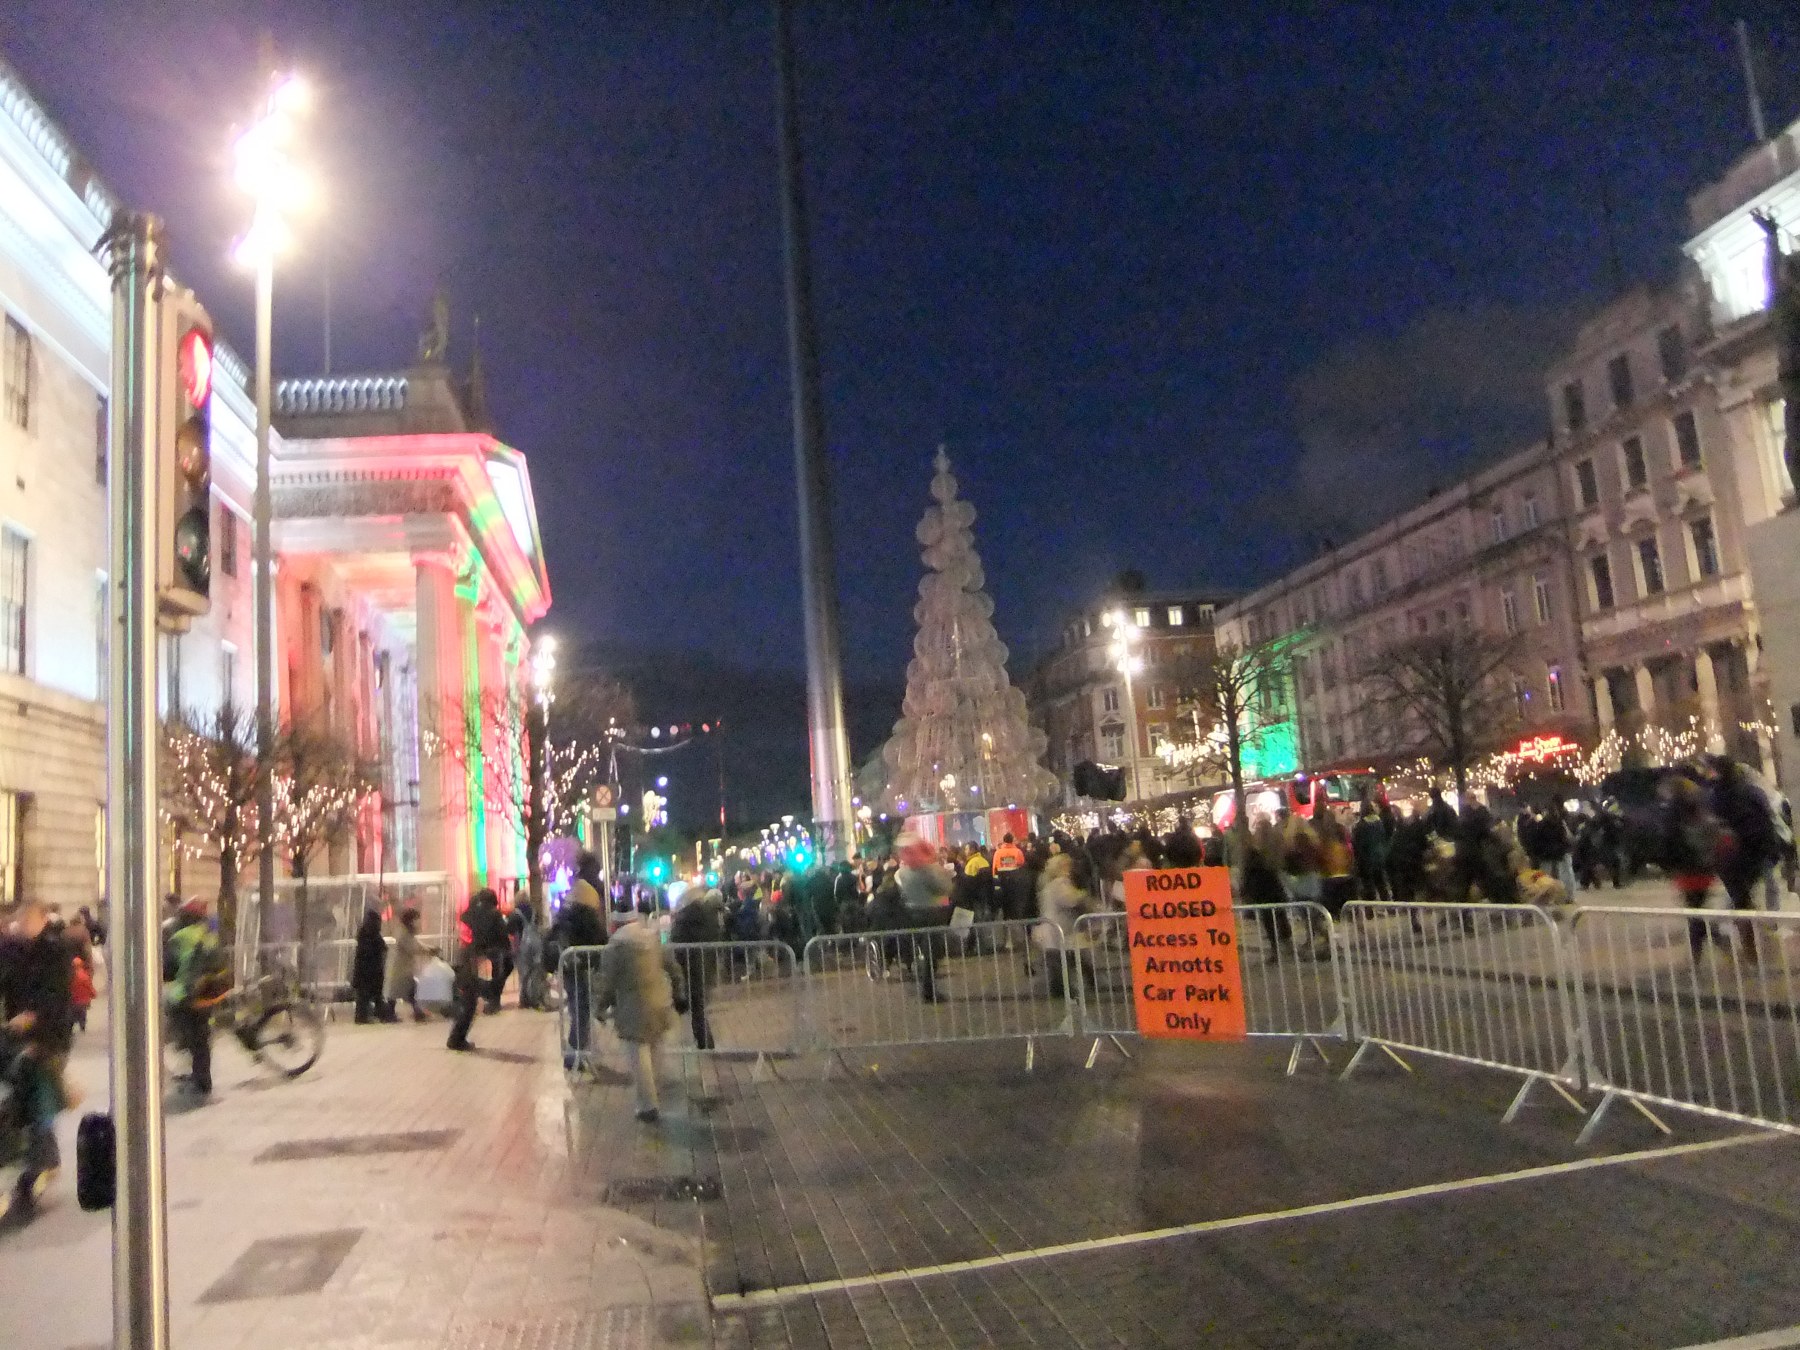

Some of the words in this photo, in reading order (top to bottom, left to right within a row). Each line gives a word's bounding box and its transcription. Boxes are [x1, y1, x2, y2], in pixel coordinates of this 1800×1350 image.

[1146, 873, 1201, 891] ROAD
[1139, 900, 1216, 919] CLOSED
[1133, 931, 1197, 947] Access
[1206, 929, 1231, 946] To
[1145, 957, 1224, 973] Arnotts
[1143, 985, 1175, 1001] Car
[1186, 985, 1230, 1002] Park
[1166, 1012, 1211, 1034] Only
